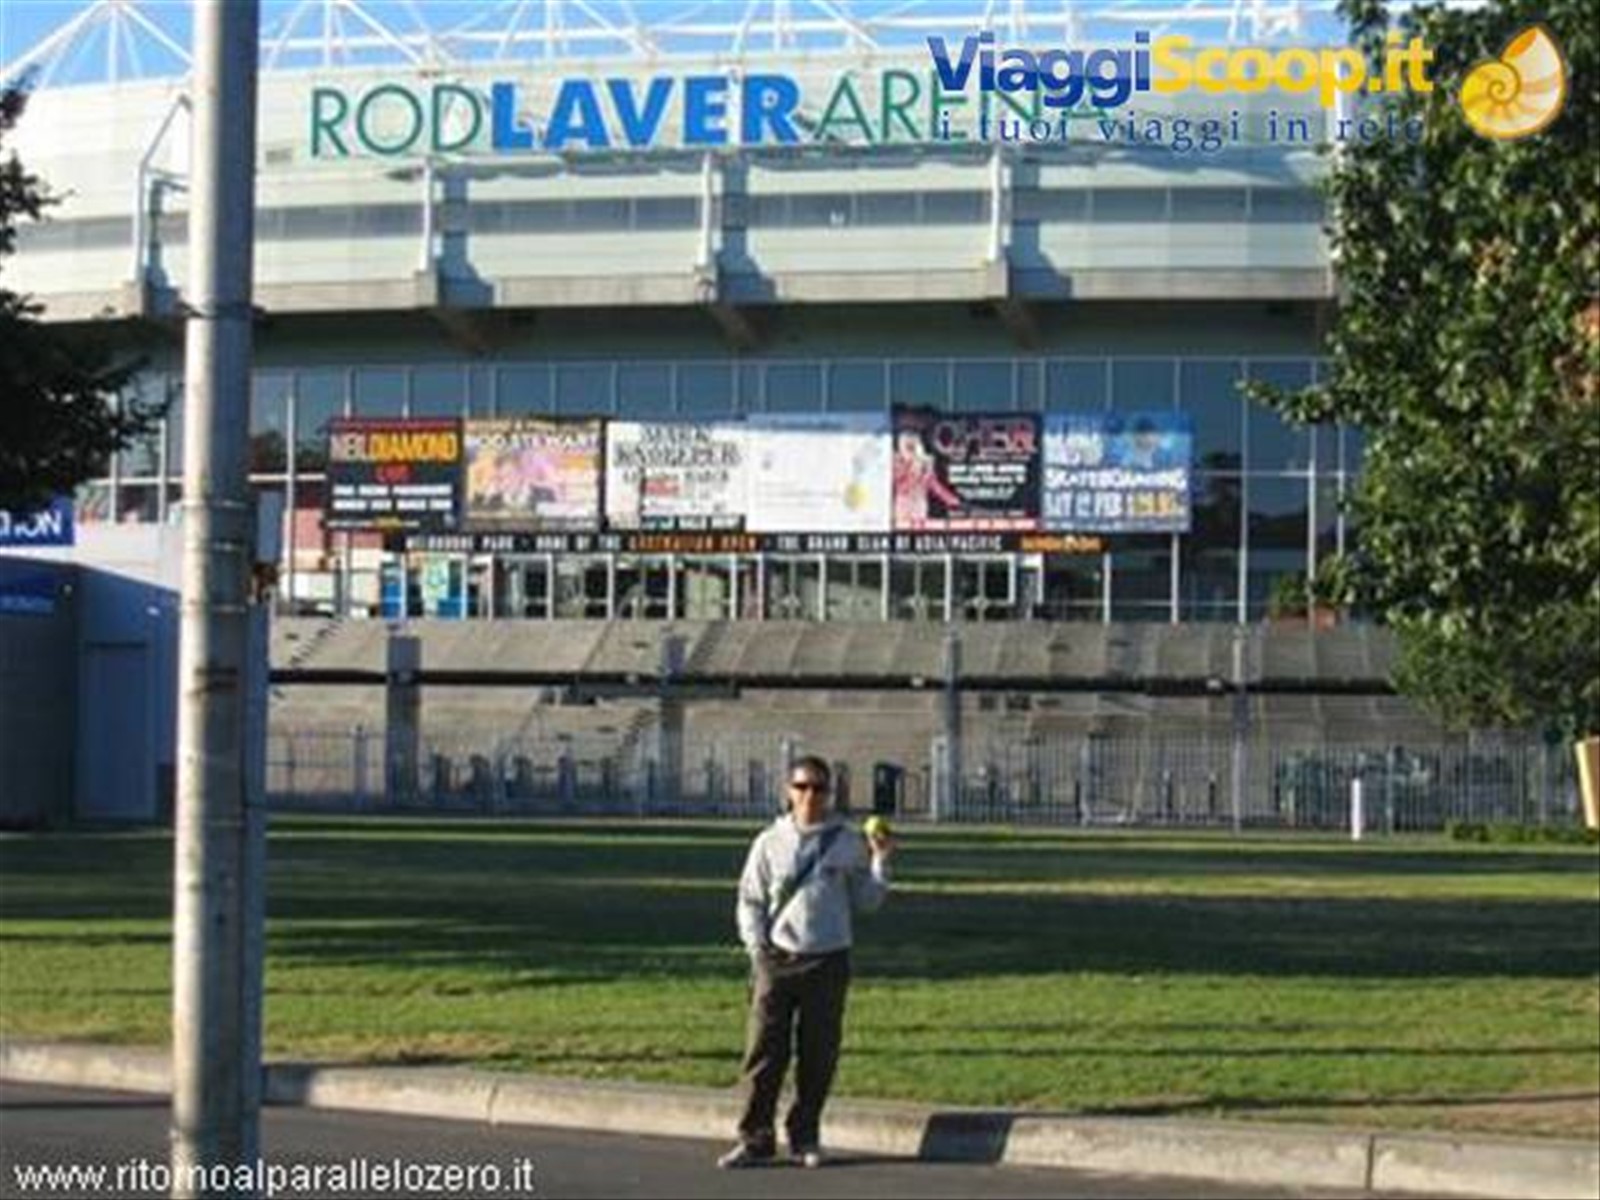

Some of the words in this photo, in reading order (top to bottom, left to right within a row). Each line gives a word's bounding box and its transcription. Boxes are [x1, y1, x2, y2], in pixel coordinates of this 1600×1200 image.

[310, 83, 483, 158] ROD
[491, 73, 801, 150] LAVER
[368, 432, 458, 462] DIAMOND
